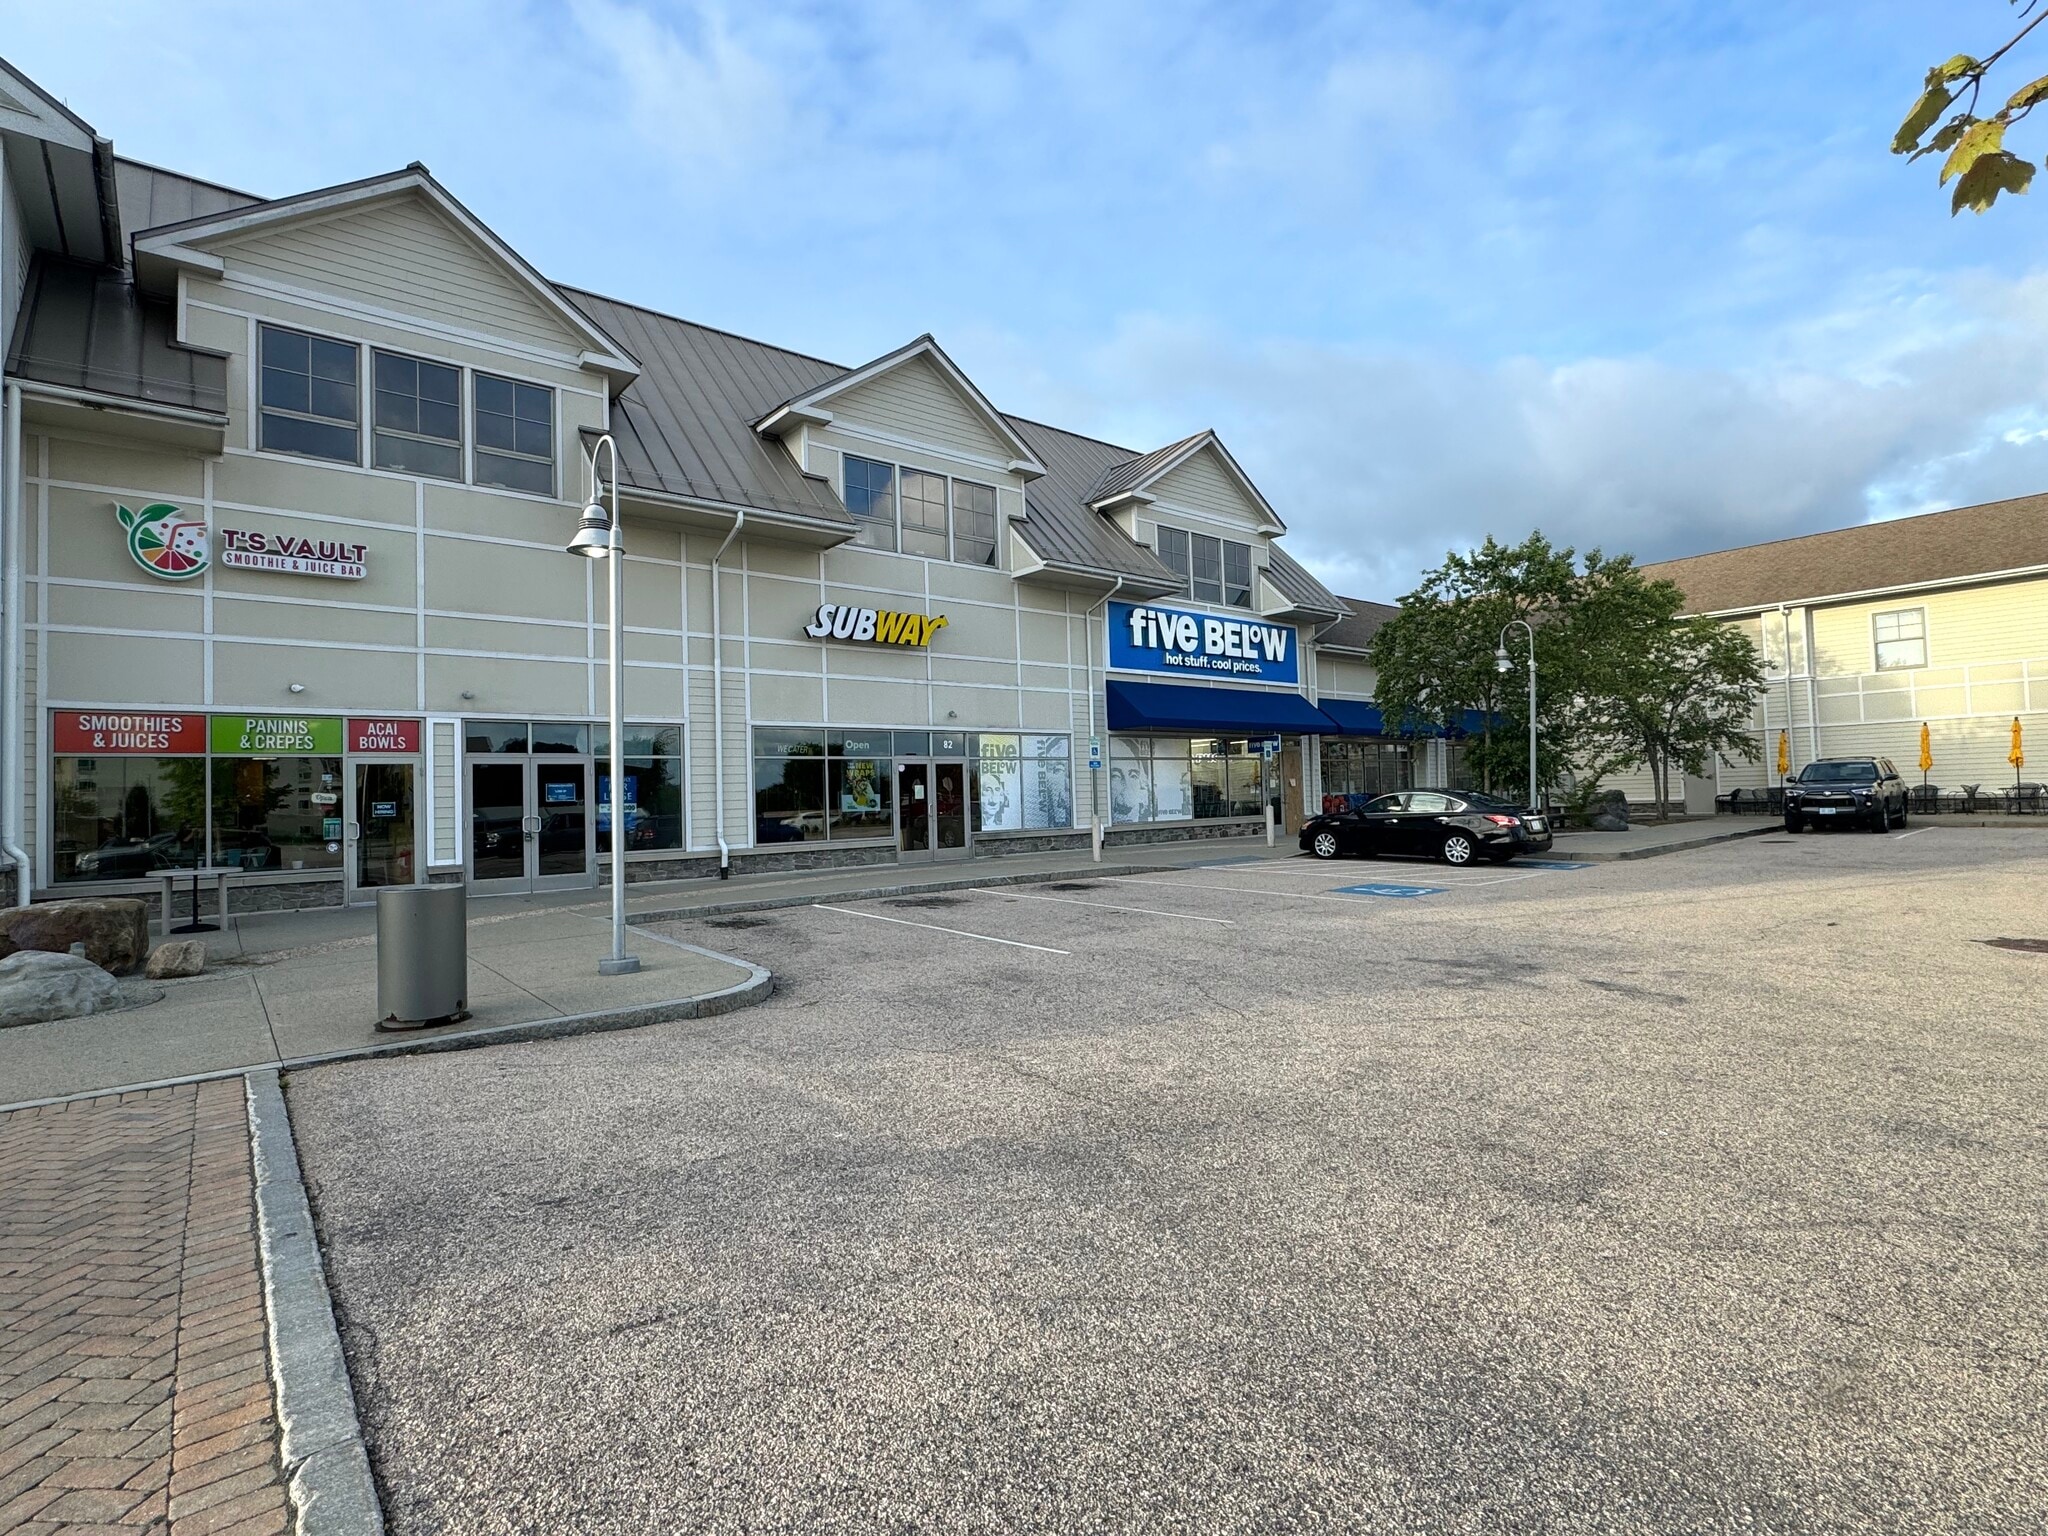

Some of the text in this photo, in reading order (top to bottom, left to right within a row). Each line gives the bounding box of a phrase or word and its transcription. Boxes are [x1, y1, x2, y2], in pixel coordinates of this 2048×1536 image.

[222, 529, 367, 562] T'S VAULT
[226, 552, 362, 577] SMOOTHIE & JUICE BAR
[805, 603, 950, 647] SUBWAY
[1129, 607, 1199, 653] five
[1166, 652, 1263, 674] hot stuff. cool prices.
[79, 715, 182, 733] SMOOTHIES
[246, 719, 309, 735] PANINIS
[93, 732, 169, 749] & JUICES
[240, 734, 314, 750] & CREPES
[359, 736, 406, 750] BOWLS
[845, 740, 870, 751] Open
[943, 740, 953, 749] 82
